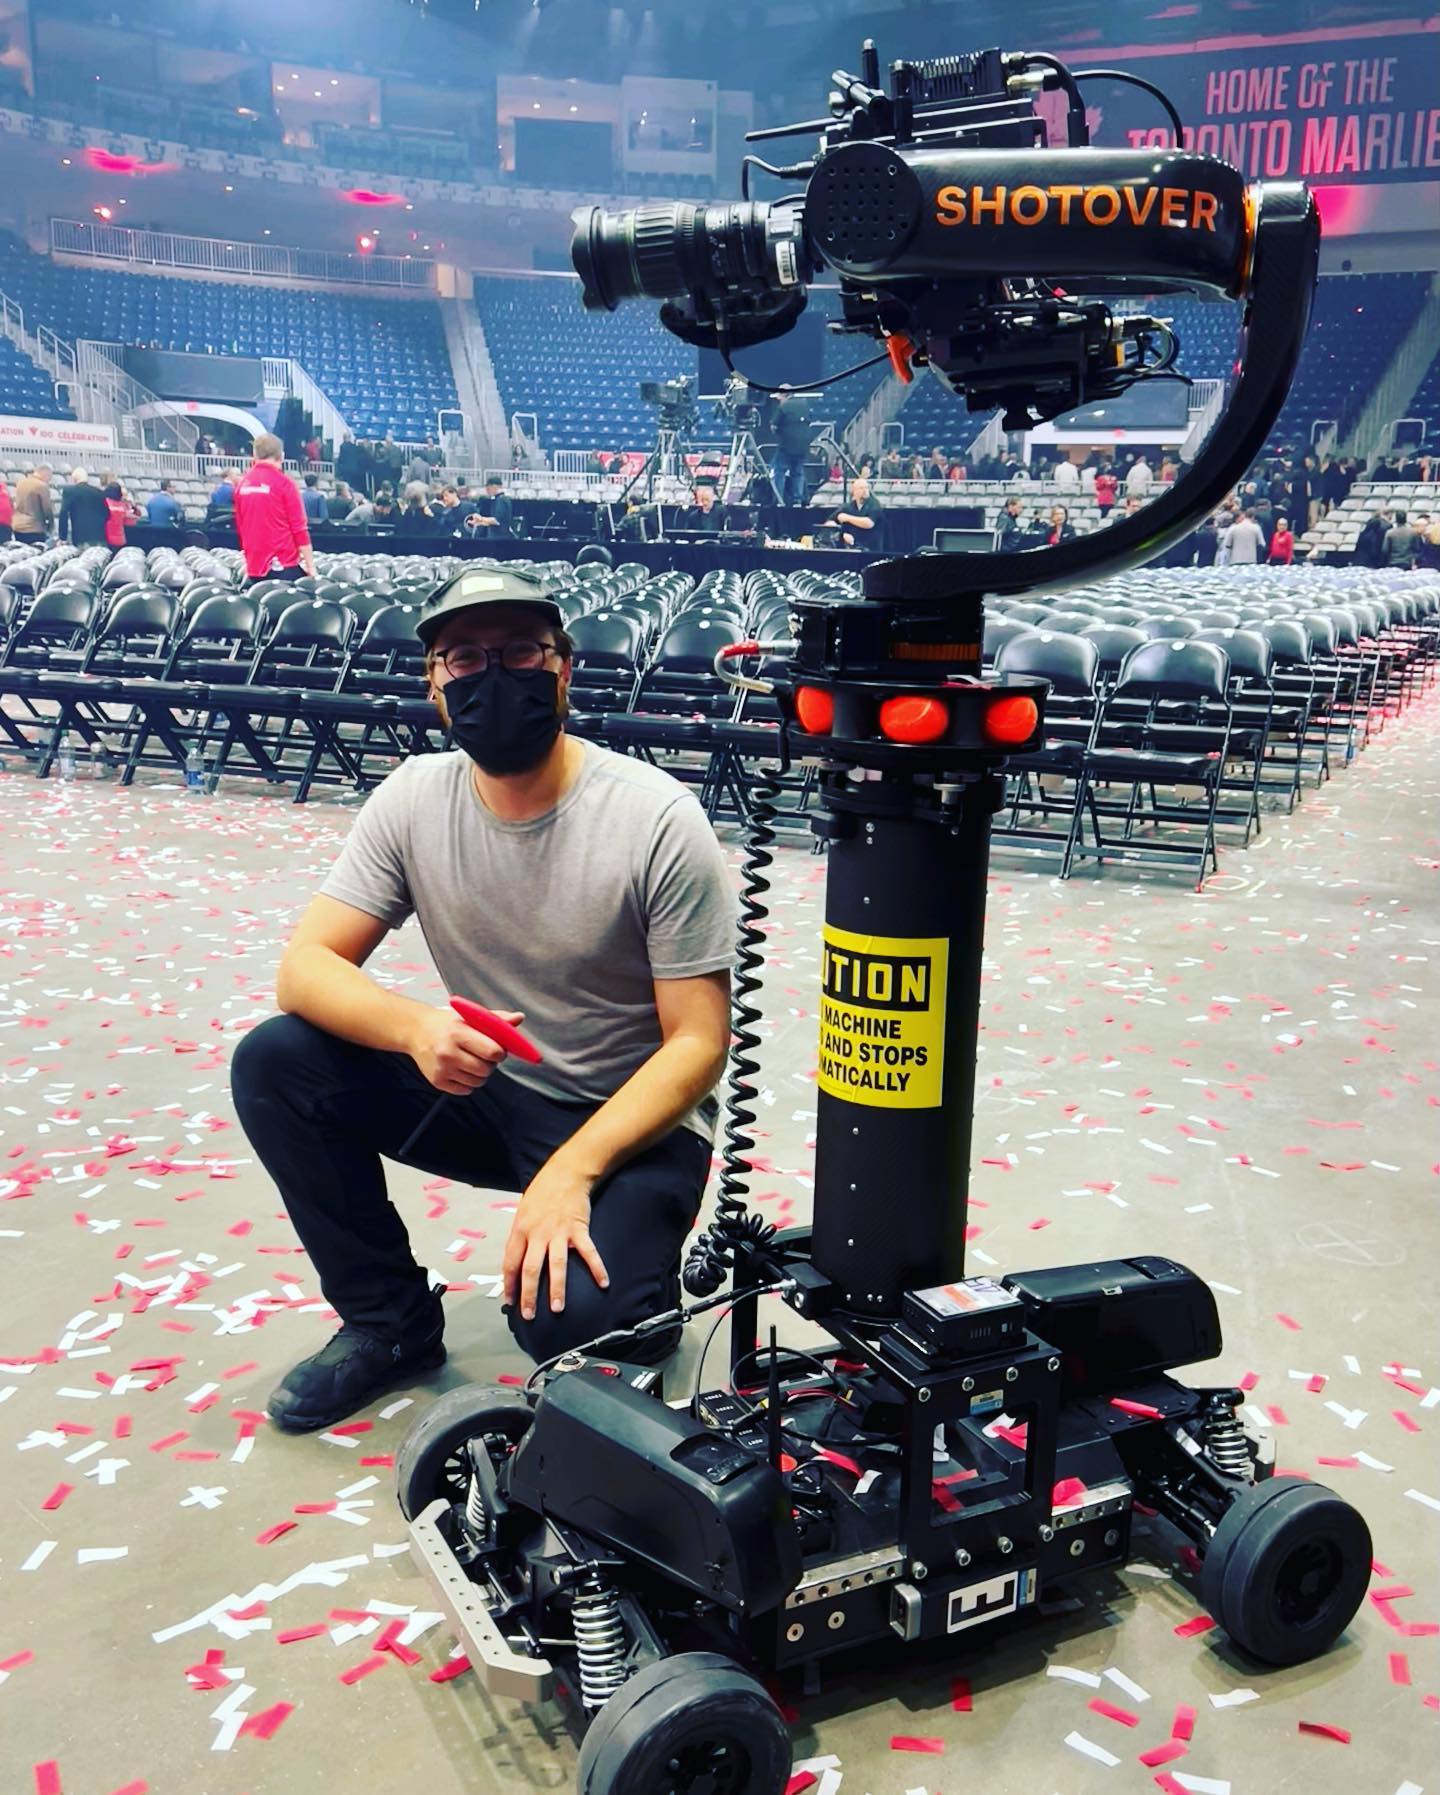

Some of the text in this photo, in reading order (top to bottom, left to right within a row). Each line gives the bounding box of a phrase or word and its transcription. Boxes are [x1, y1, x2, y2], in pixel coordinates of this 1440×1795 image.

[1206, 57, 1398, 114] HOME OF THE
[936, 185, 1218, 232] SHOTOVER
[823, 949, 927, 1003] TION
[824, 1005, 902, 1040] MACHINE
[825, 1031, 853, 1058] AND
[859, 1043, 928, 1067] STOPS
